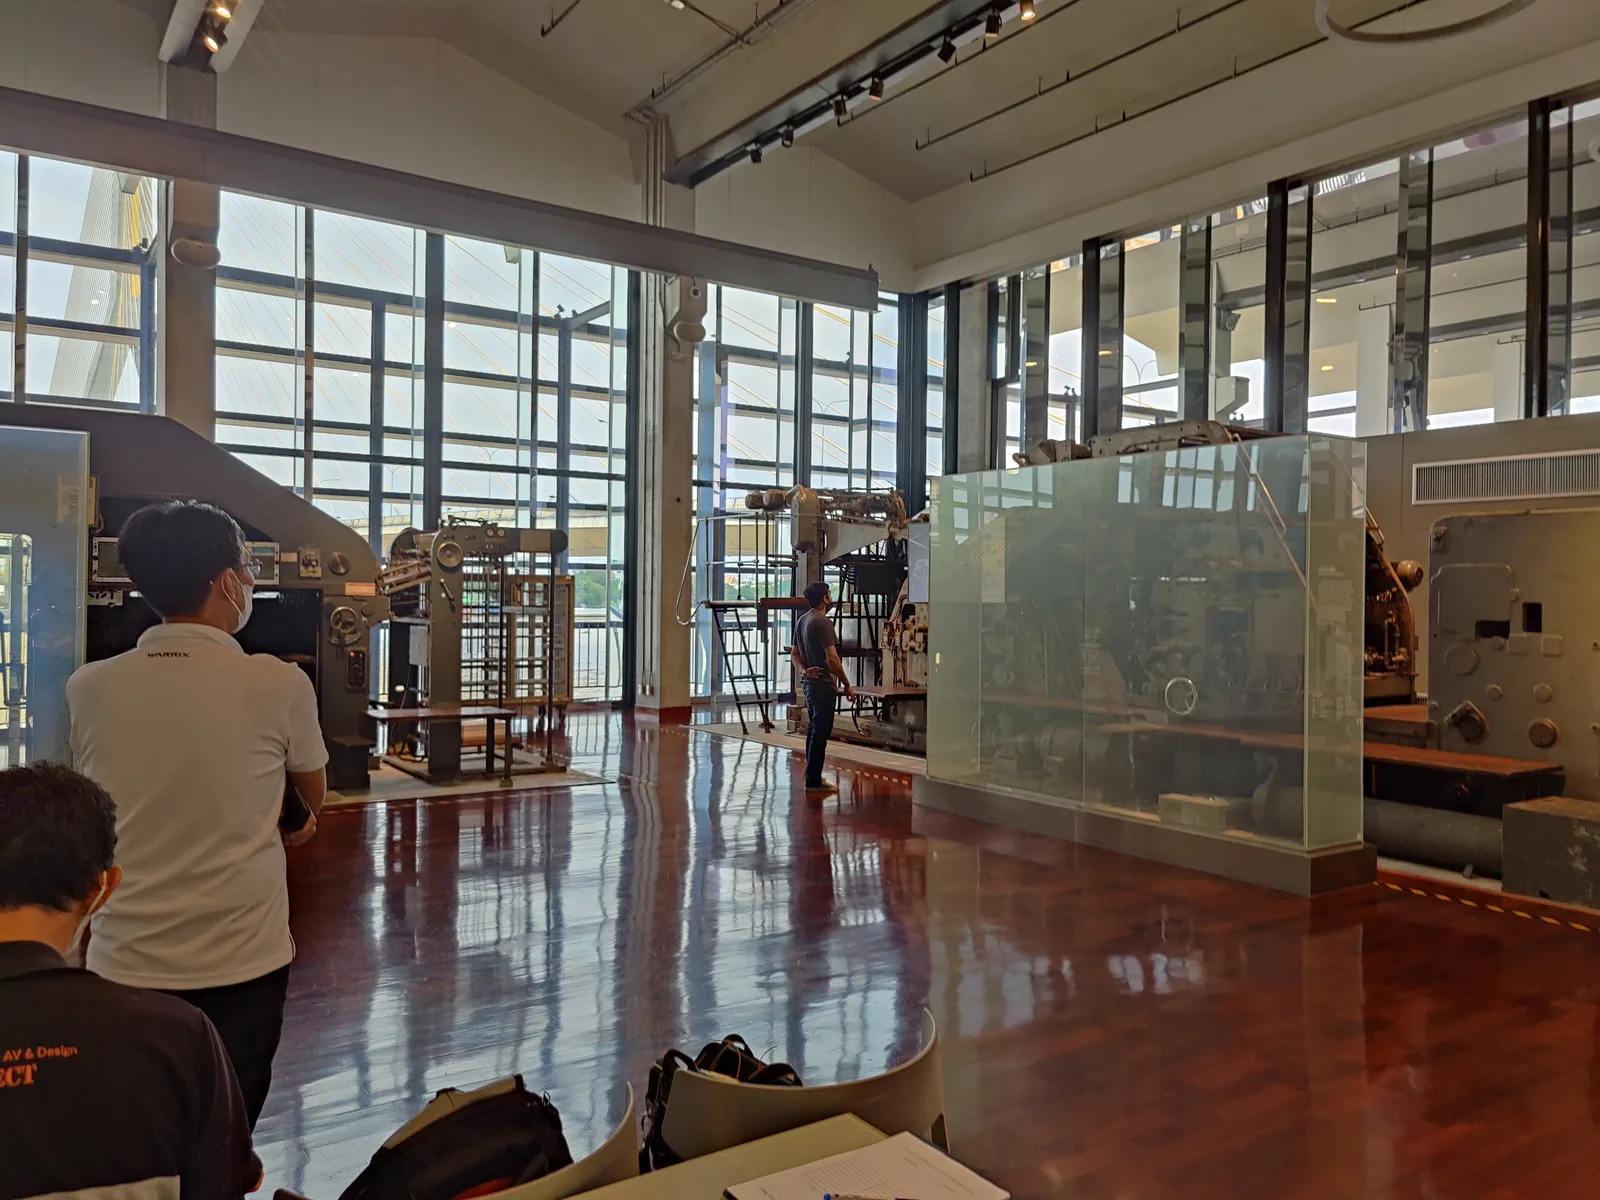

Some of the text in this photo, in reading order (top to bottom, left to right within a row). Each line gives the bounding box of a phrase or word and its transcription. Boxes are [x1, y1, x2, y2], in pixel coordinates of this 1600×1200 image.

[2, 1045, 78, 1062] AV & Design
